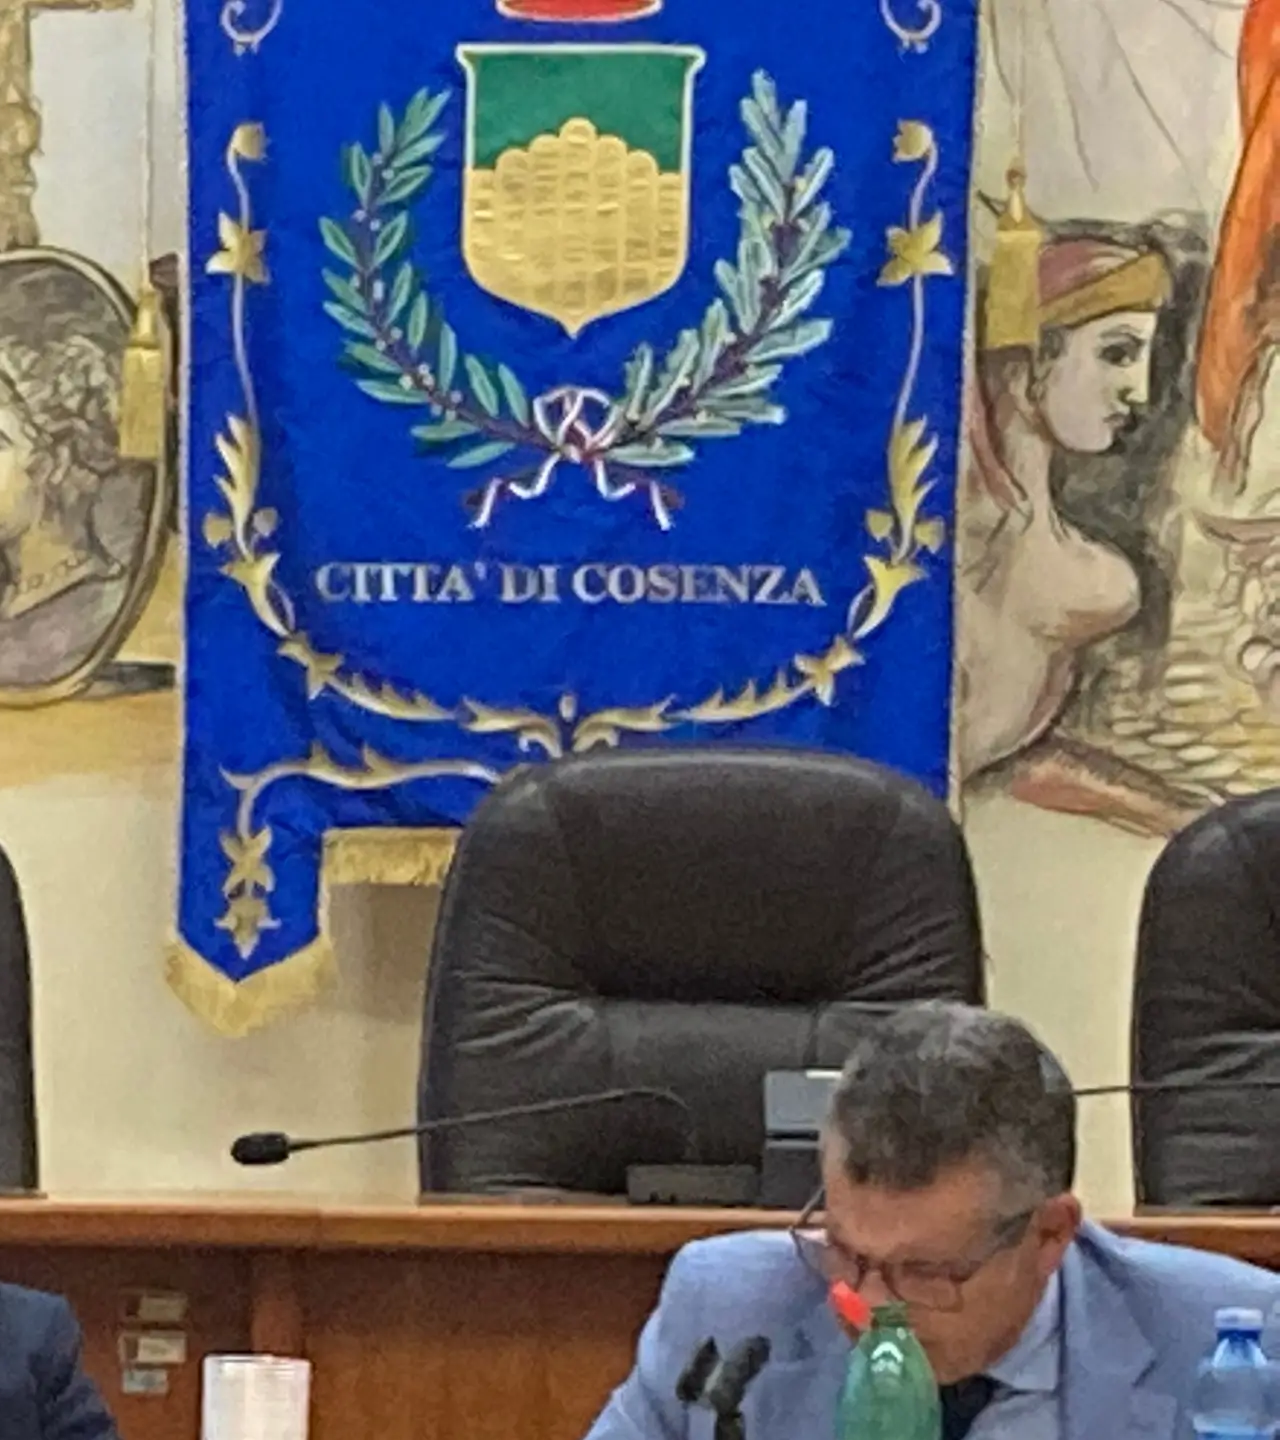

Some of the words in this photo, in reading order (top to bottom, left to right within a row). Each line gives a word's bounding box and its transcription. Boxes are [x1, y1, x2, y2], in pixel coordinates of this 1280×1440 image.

[314, 561, 487, 603] CITTA'
[500, 563, 561, 604] DI
[570, 563, 828, 607] COSENZA
